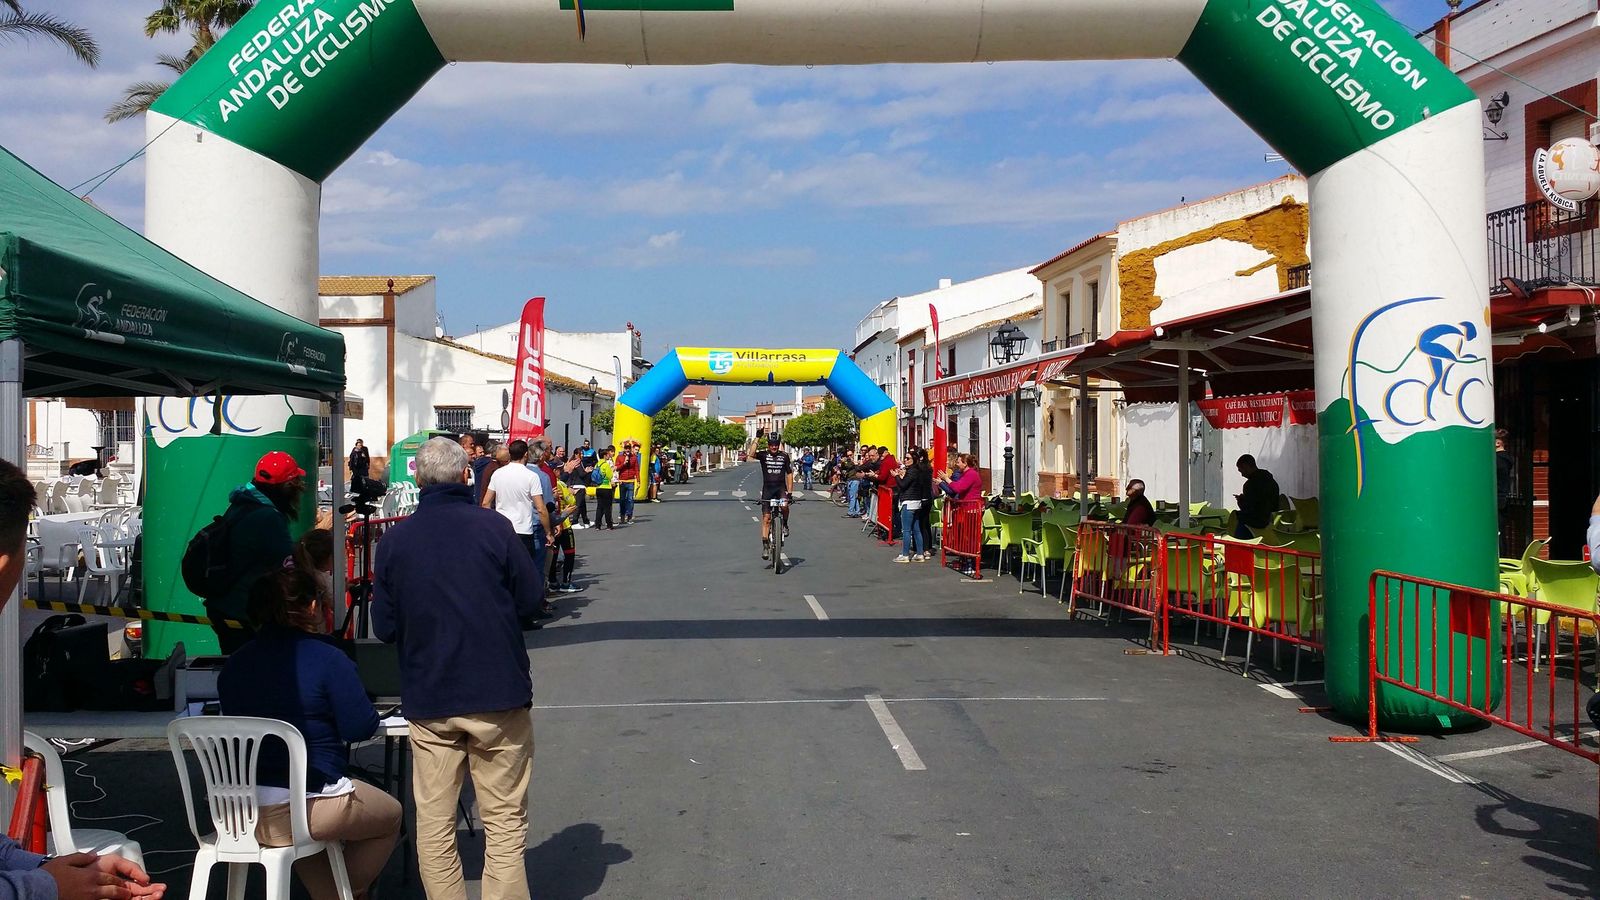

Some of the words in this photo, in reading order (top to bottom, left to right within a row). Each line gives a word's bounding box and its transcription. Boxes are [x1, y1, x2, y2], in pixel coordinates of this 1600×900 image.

[1277, 0, 1363, 68] ALUZA
[216, 8, 335, 123] ANDALUZA
[1256, 6, 1297, 41] DE
[1290, 36, 1396, 130] CICLISMO
[266, 71, 304, 110] DE
[1539, 153, 1547, 162] LA
[1538, 164, 1550, 193] ABUELA
[1548, 193, 1574, 209] KUBICA
[114, 318, 153, 336] ANDALUZA
[736, 351, 807, 363] Villarrasa
[985, 373, 1011, 394] FUNDADA
[1224, 400, 1237, 410] CAFÉ
[1237, 400, 1249, 409] BAR
[1226, 412, 1252, 424] ABUELA
